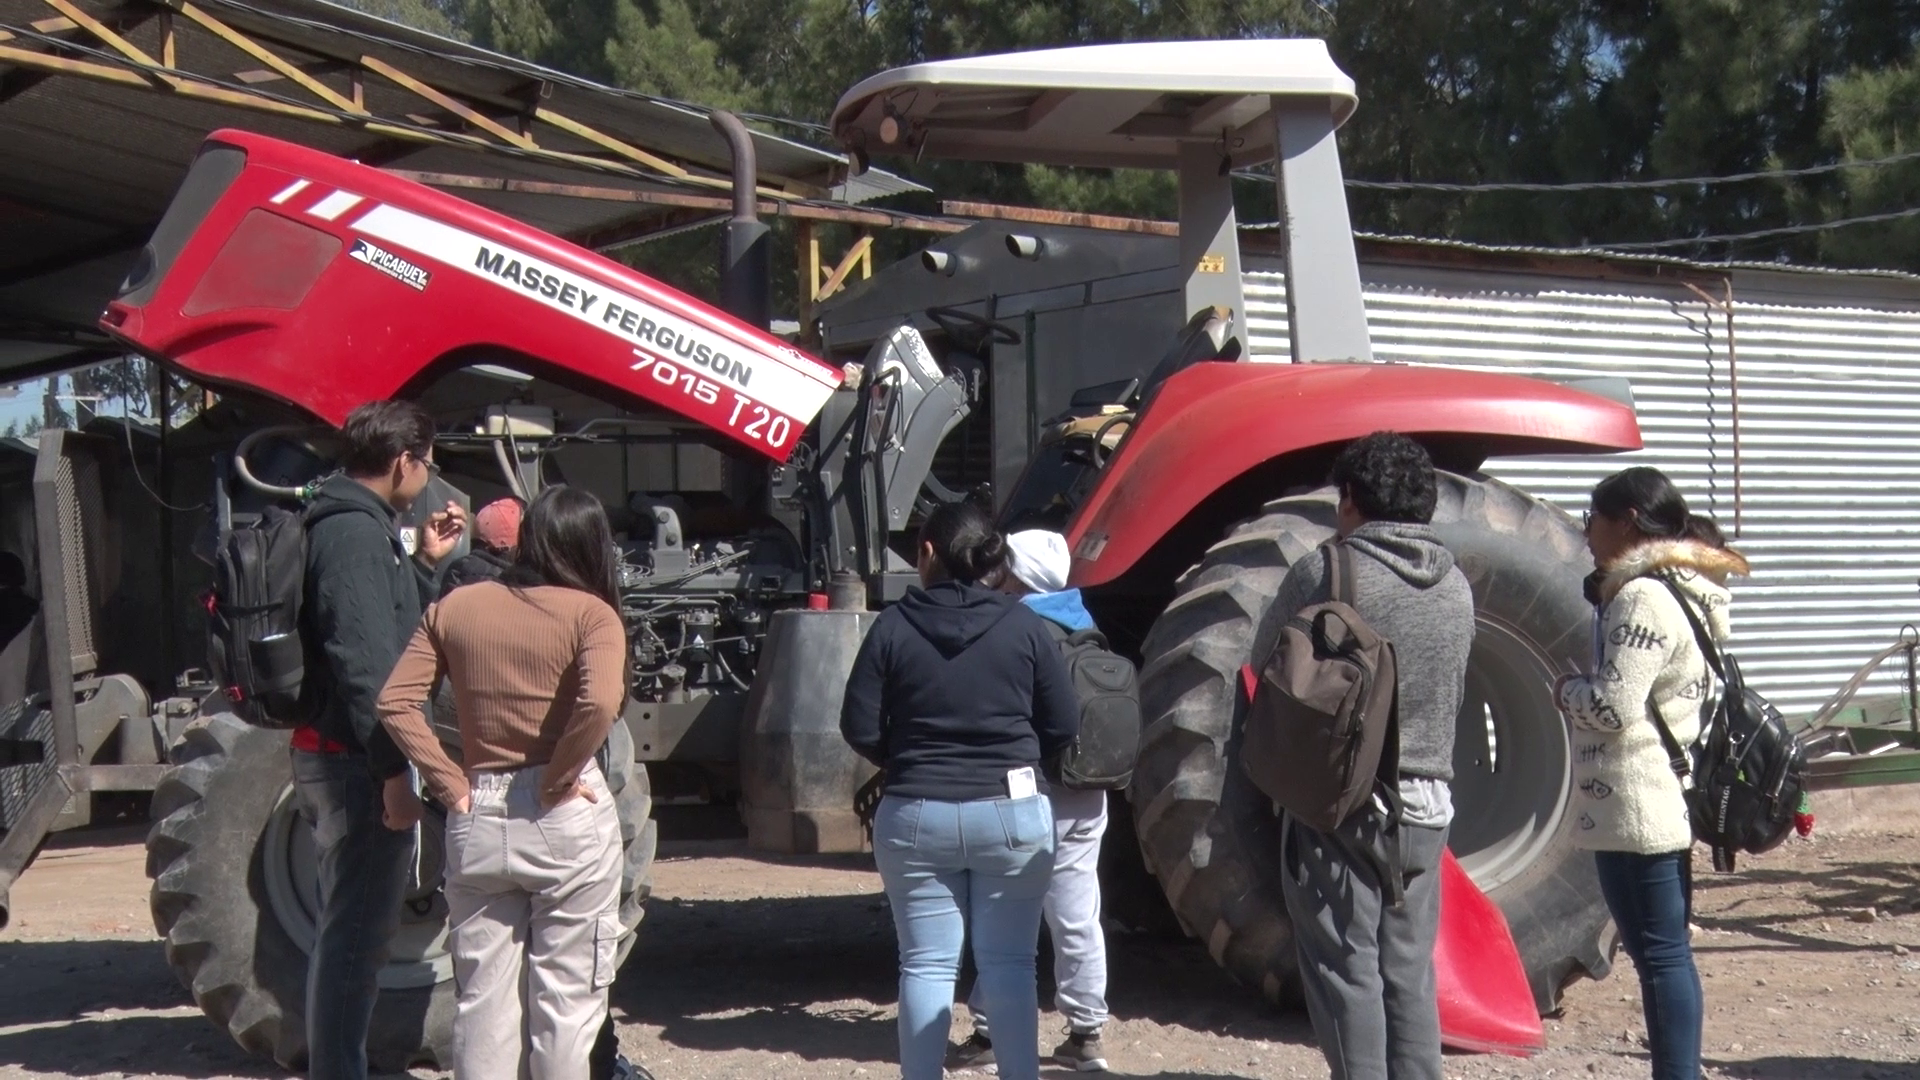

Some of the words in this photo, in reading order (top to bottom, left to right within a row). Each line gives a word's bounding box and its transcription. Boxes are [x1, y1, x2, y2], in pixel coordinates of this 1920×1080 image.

[373, 247, 427, 283] PICABUEY
[474, 246, 599, 315] MASSEY
[602, 301, 753, 388] FERGUSON
[629, 348, 721, 405] 7015
[728, 393, 791, 448] T20
